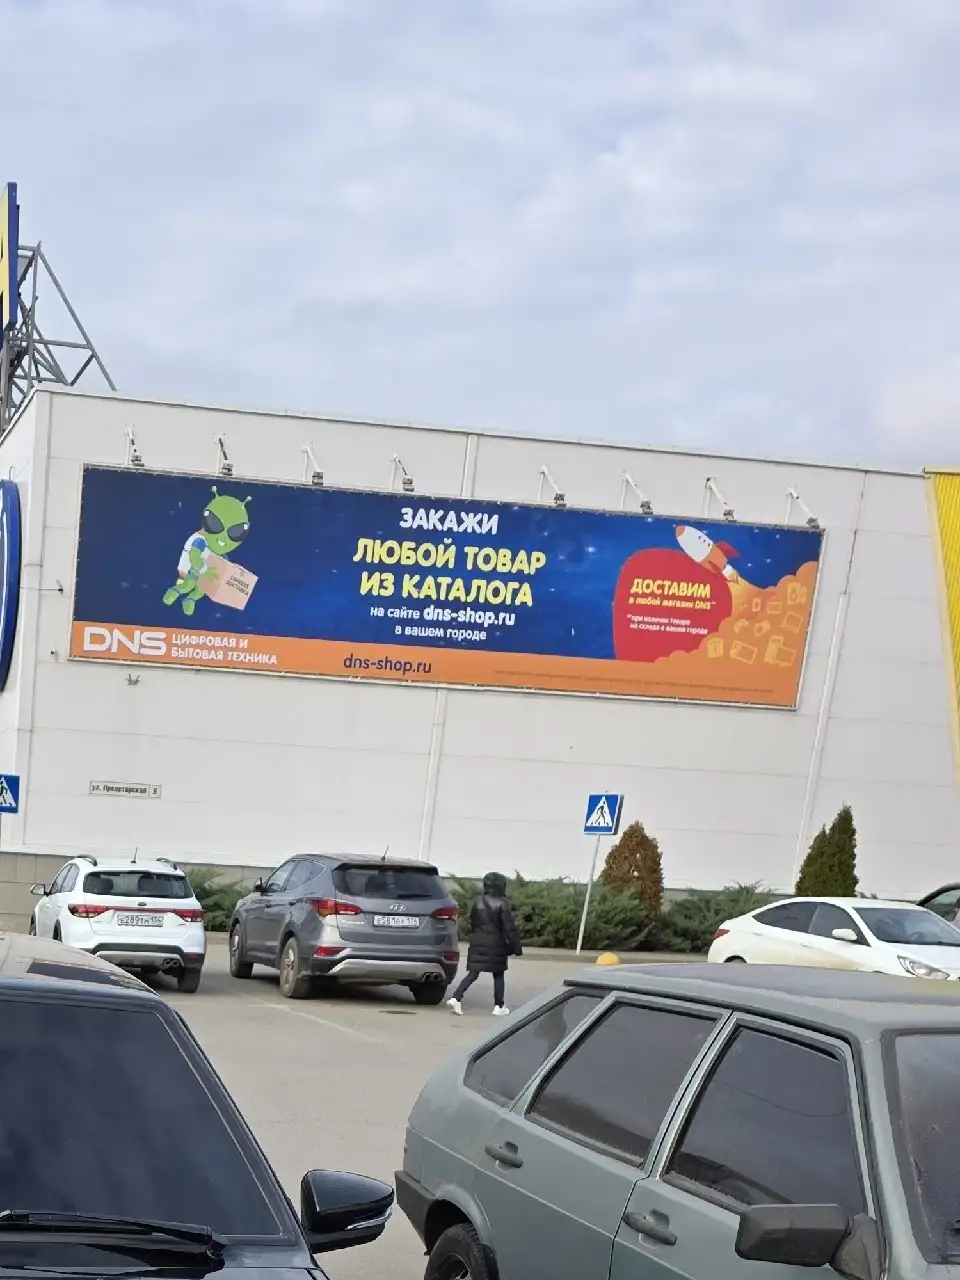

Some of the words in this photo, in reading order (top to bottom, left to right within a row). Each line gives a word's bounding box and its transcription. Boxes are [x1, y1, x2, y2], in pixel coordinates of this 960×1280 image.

[399, 507, 499, 535] ЗАКАЖИ
[353, 538, 456, 569] ЛЮБОЙ
[464, 547, 546, 575] ТОВАР
[360, 571, 395, 596] ИЗ
[402, 574, 533, 607] КАТАЛОГА
[630, 578, 711, 598] ДОСТАВИМ
[636, 596, 661, 606] любой
[662, 599, 693, 609] магазин
[370, 606, 384, 617] на
[387, 606, 420, 619] сайте
[423, 605, 516, 627] dns-shop.ru
[83, 626, 167, 656] DNS
[172, 633, 236, 648] ЦИФРОВАЯ
[239, 639, 248, 649] И
[395, 625, 401, 635] в
[405, 626, 444, 637] вашем
[447, 628, 487, 641] городе
[171, 647, 224, 661] БЫТОВАЯ
[227, 652, 277, 665] ТЕХНИКА
[343, 652, 432, 675] dns-shop.ru
